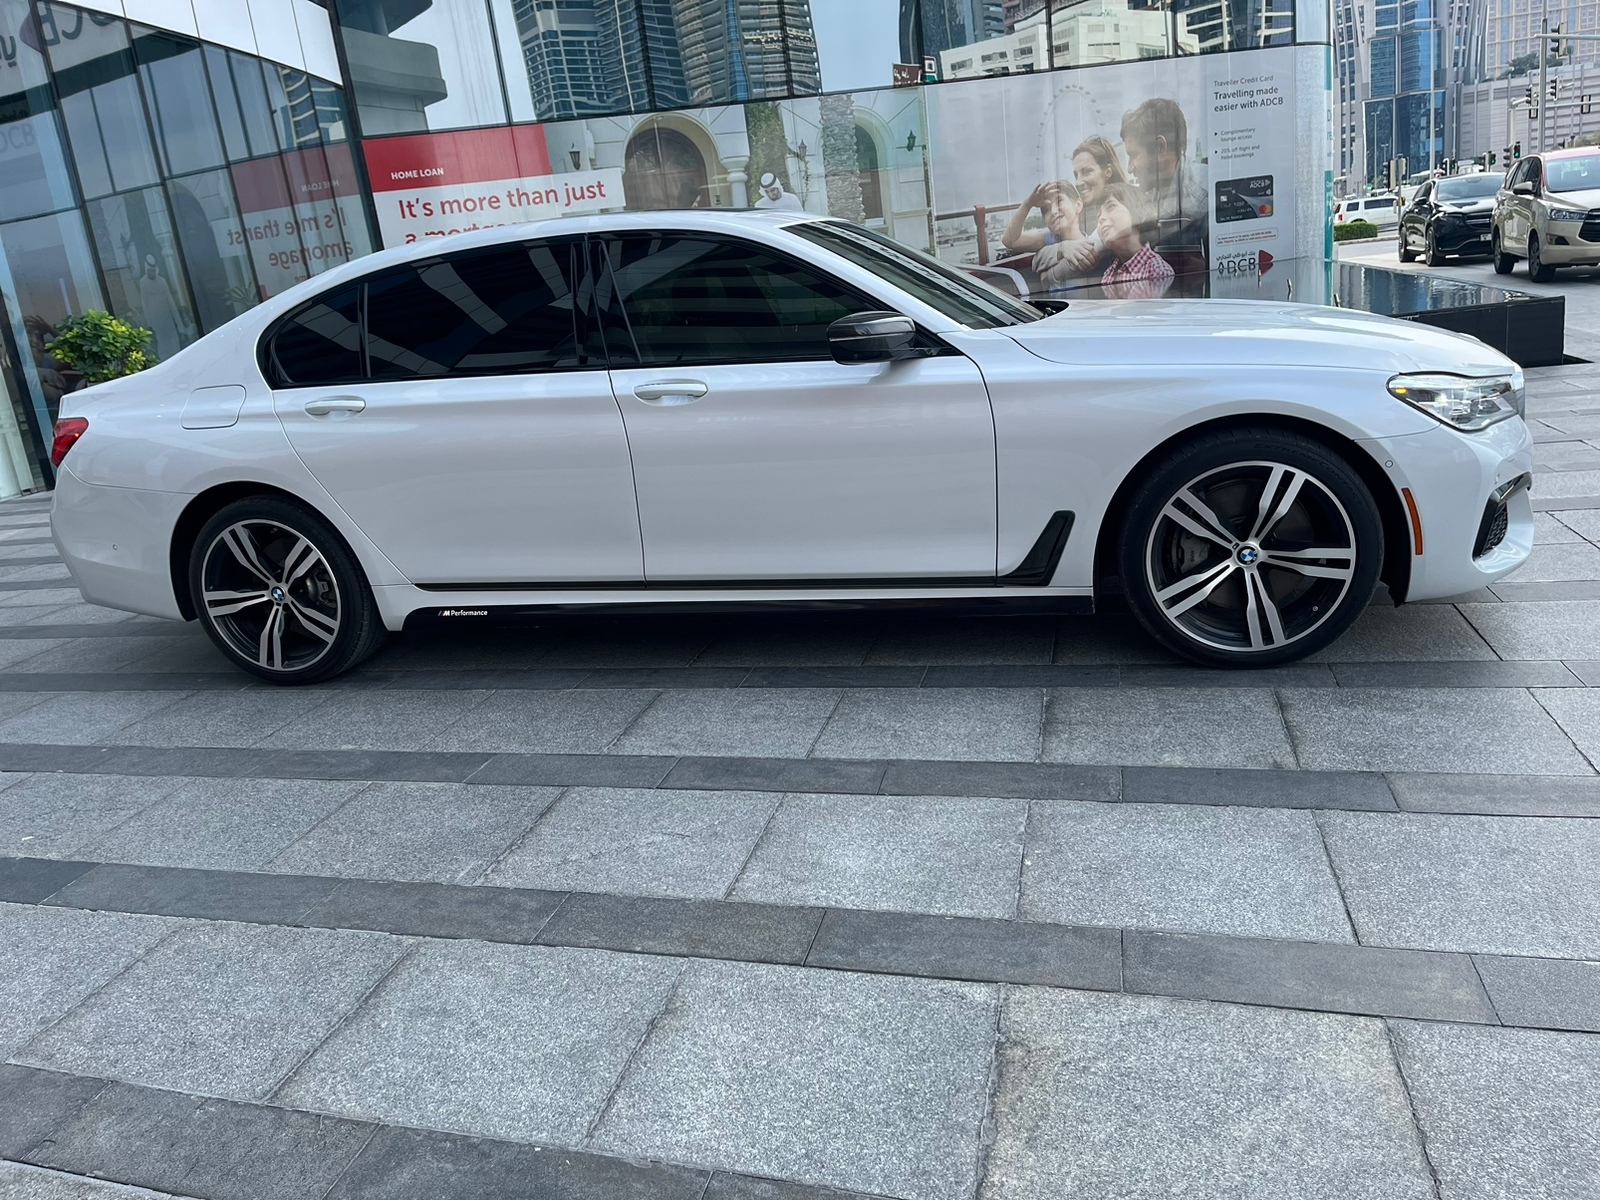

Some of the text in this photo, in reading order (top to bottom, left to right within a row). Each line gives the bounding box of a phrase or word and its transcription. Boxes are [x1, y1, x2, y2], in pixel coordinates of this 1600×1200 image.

[1213, 86, 1279, 100] Travelling made
[1213, 96, 1284, 112] easier with ADCB
[391, 167, 445, 180] HOME LOAN
[398, 180, 606, 219] It's more than just
[1218, 257, 1256, 274] ADCB
